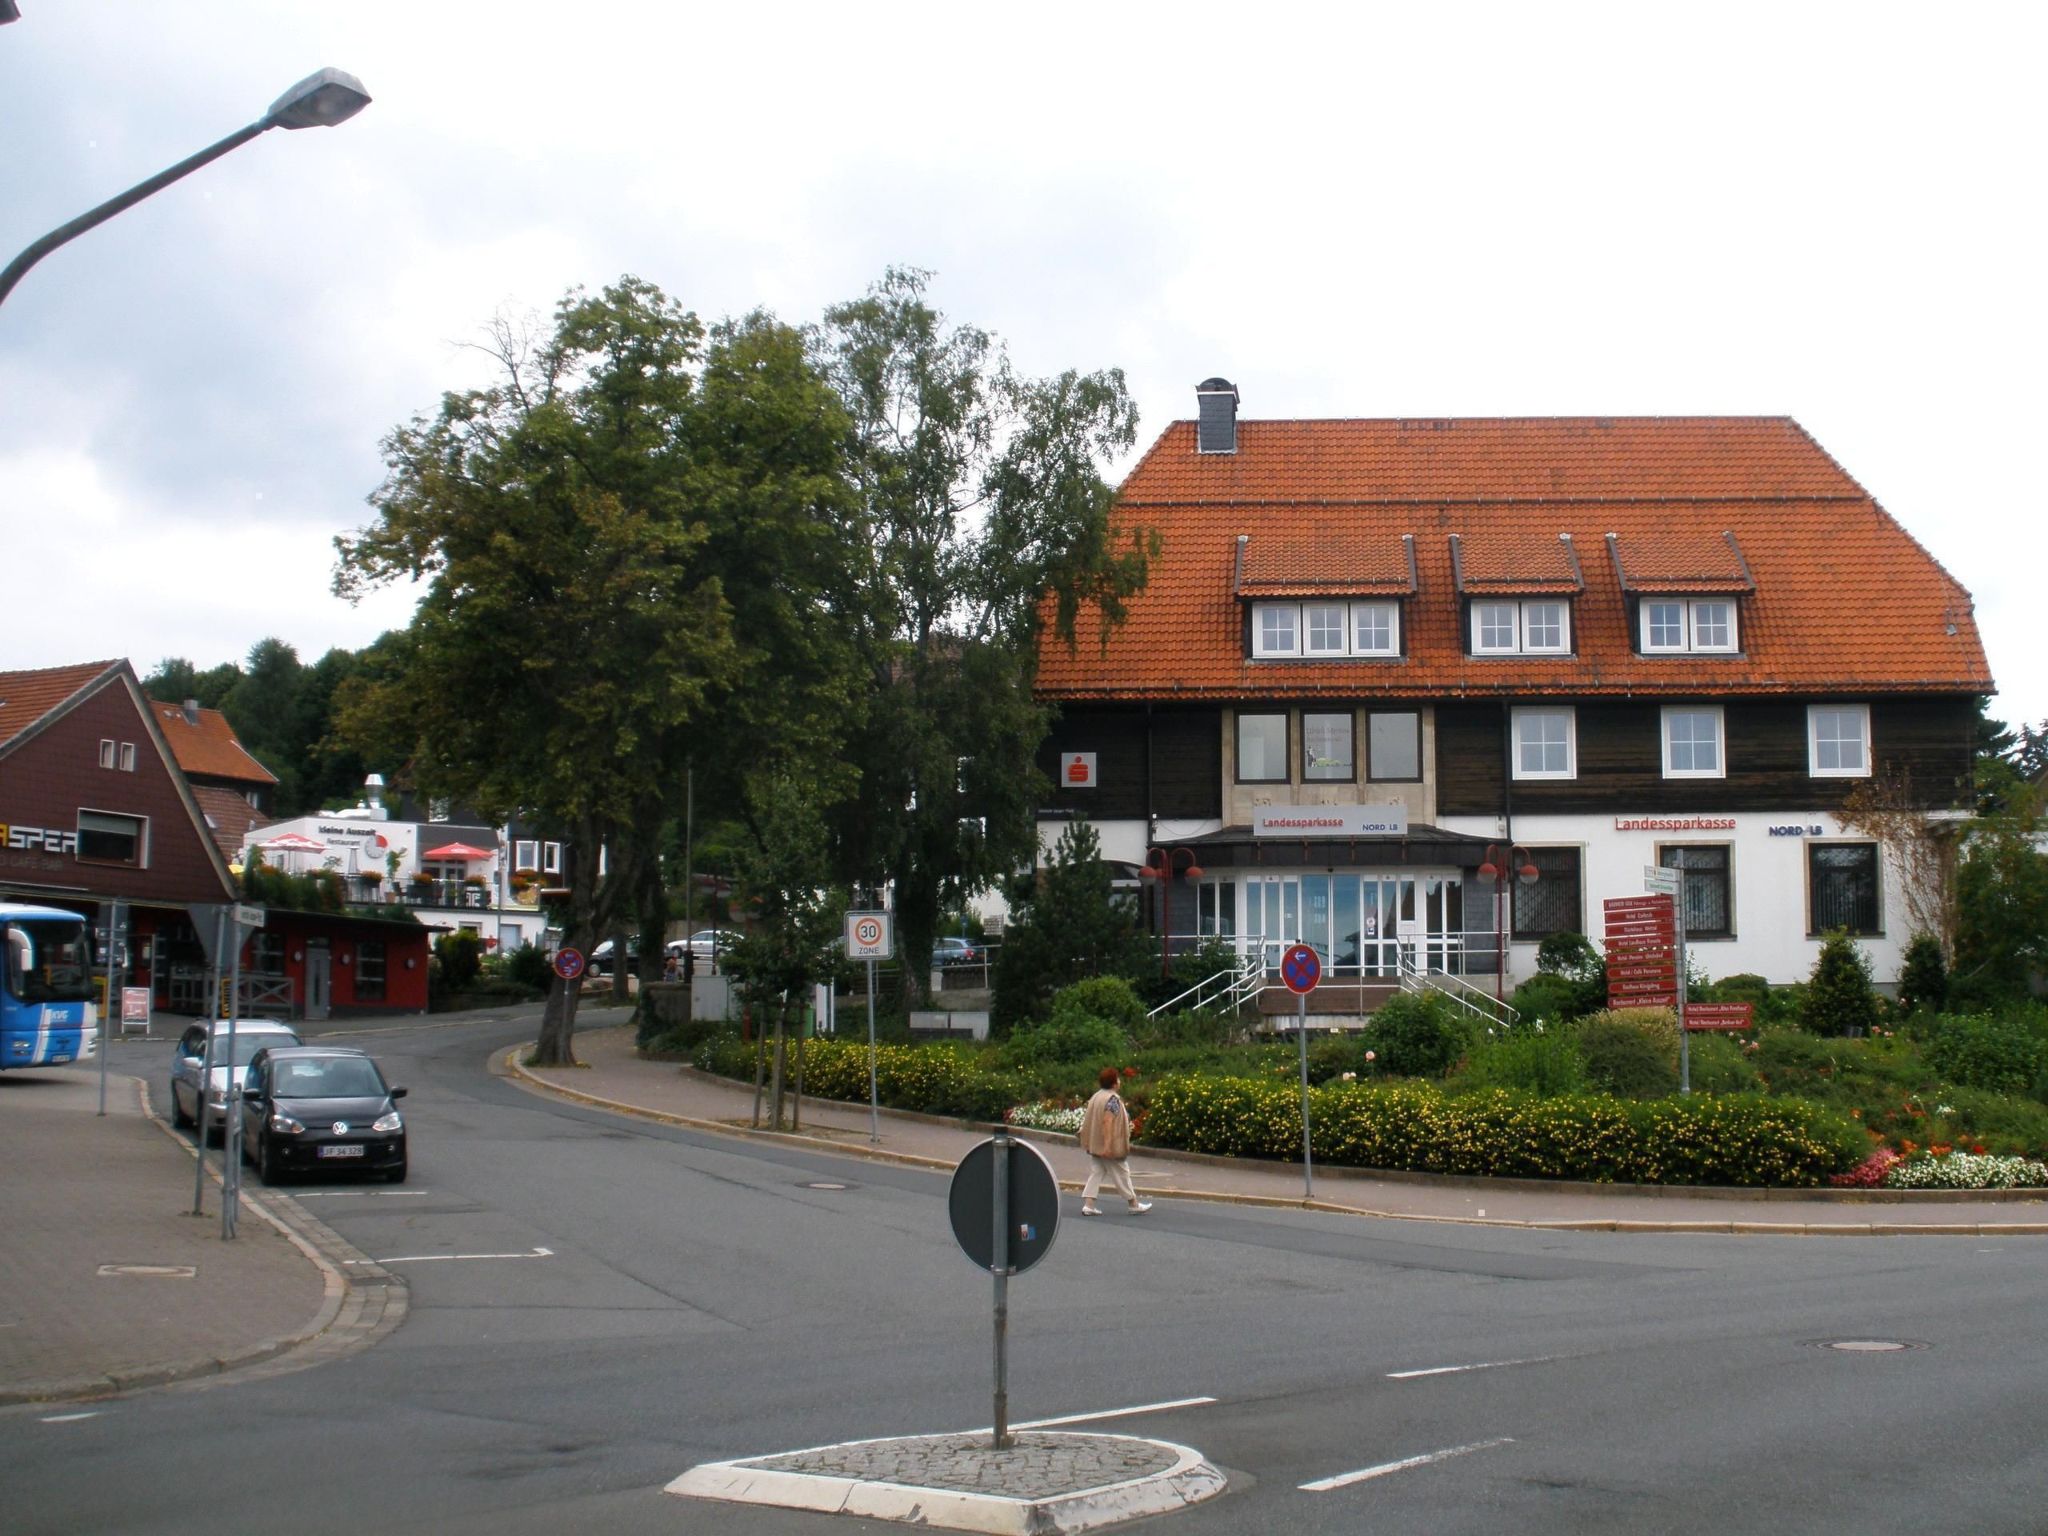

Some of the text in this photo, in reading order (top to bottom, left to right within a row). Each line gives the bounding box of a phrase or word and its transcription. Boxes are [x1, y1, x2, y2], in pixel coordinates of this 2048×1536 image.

[1263, 817, 1344, 828] Landessparkasse
[1615, 816, 1736, 832] Landessparkasse
[346, 827, 376, 836] Auszeit
[1769, 826, 1823, 836] NORD LB
[861, 925, 876, 938] 30
[858, 947, 879, 955] ZONE
